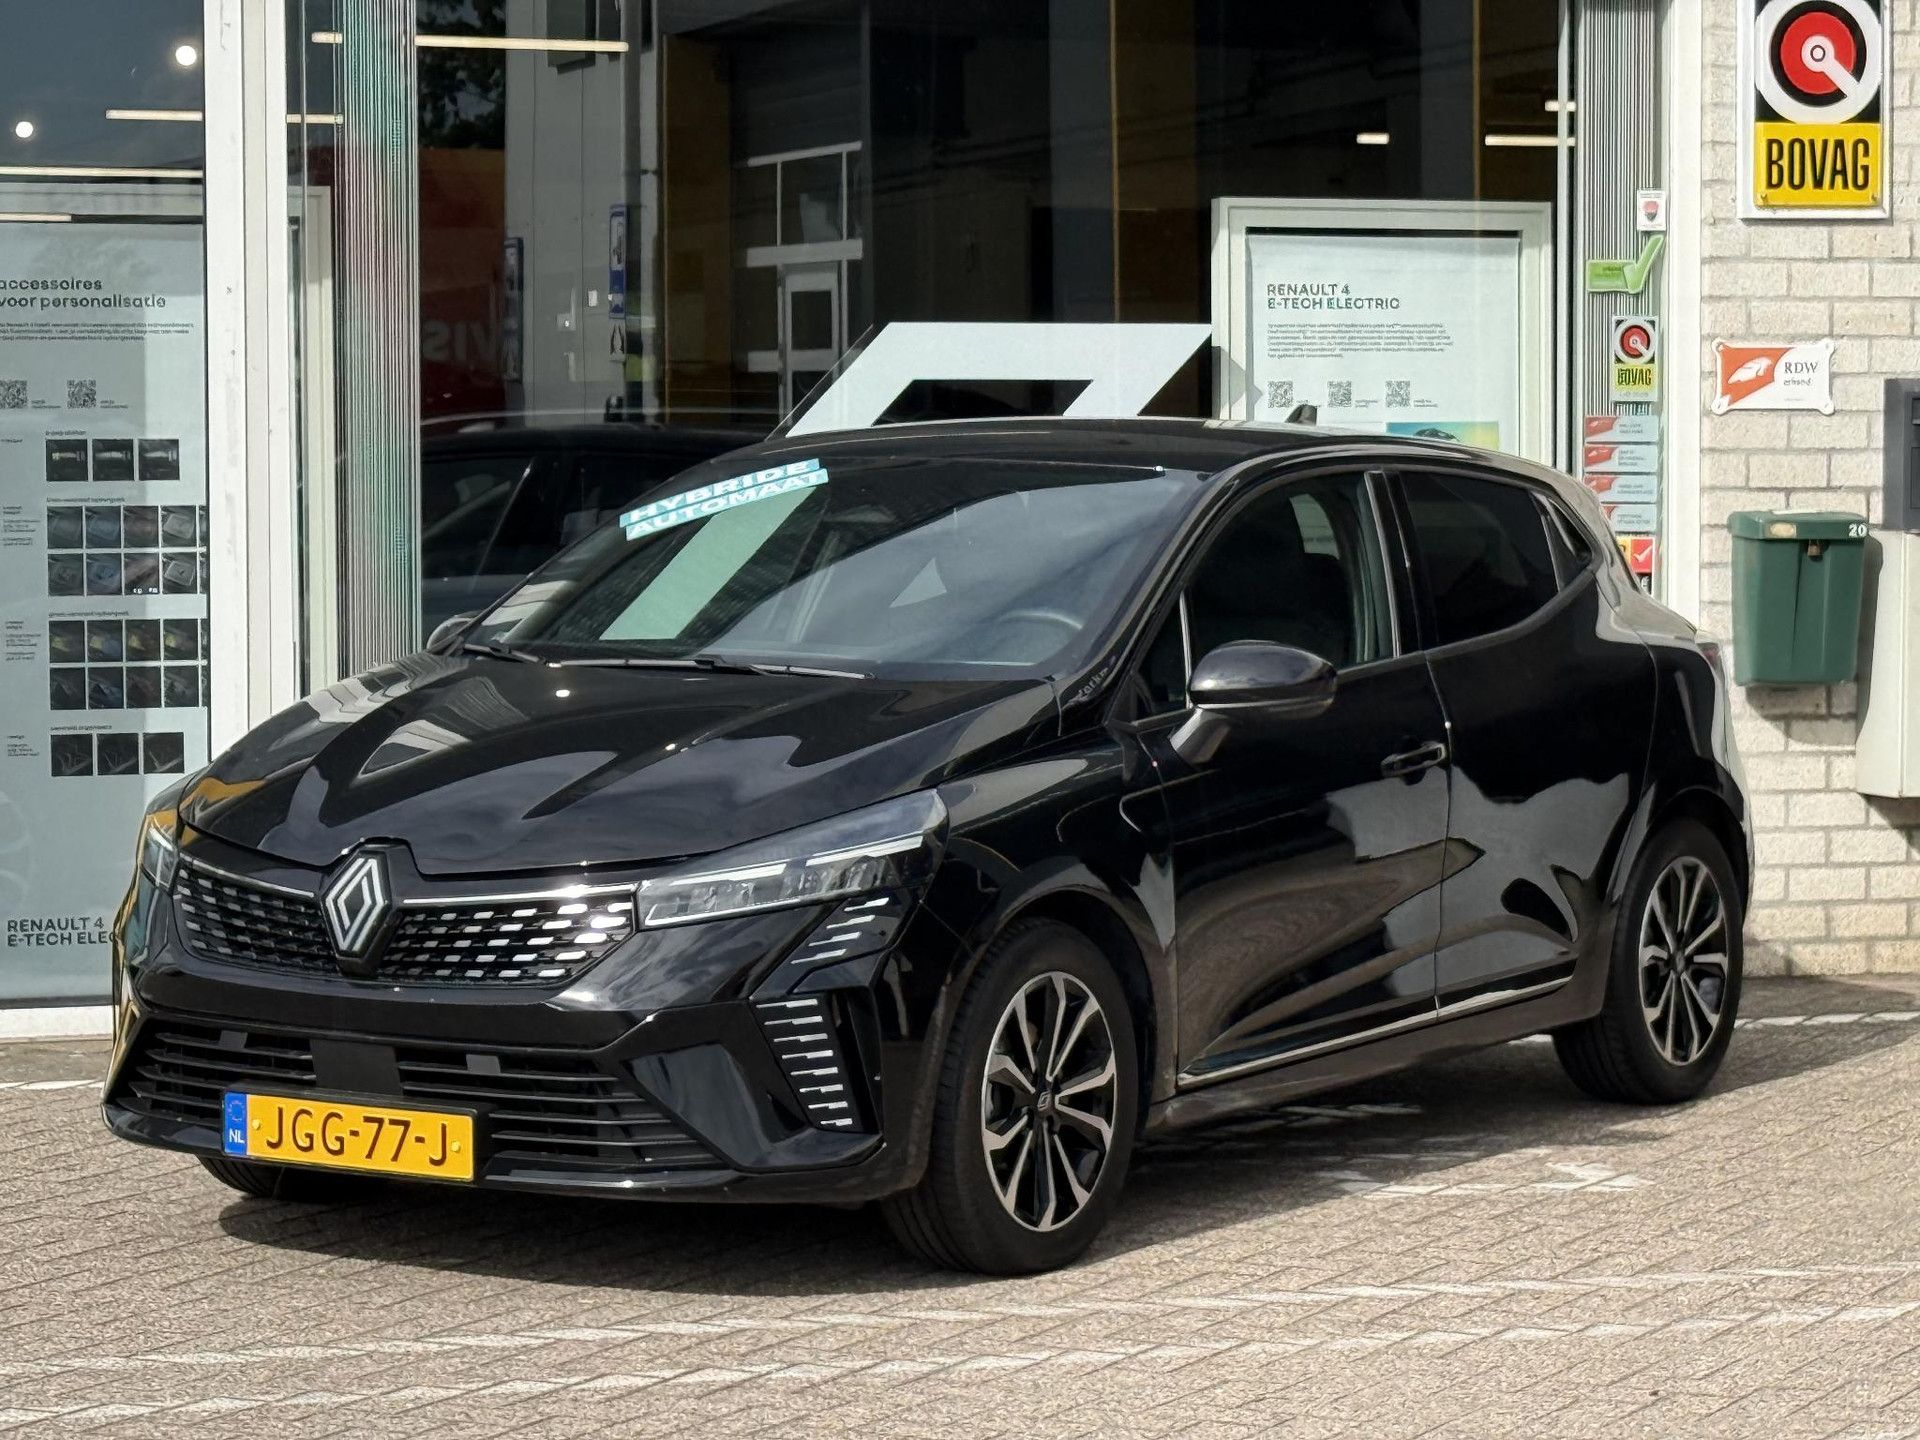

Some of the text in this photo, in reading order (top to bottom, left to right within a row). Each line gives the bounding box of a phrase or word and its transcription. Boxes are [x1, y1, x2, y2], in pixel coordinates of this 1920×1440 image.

[1765, 137, 1870, 190] BOVAG
[1266, 284, 1351, 296] RENAULT 4
[40, 294, 167, 310] personalisatie
[1267, 297, 1400, 310] E-TECH ELECTRIC
[1784, 361, 1818, 374] RDW
[1617, 367, 1652, 386] BOVAG
[630, 461, 809, 523] HYBRIDE
[627, 469, 823, 540] AUTOMAAT
[1849, 523, 1868, 537] 20
[7, 917, 104, 932] RENAULT 4
[7, 932, 72, 947] E-TECH
[229, 1129, 245, 1144] NL
[266, 1106, 447, 1167] JGG-77-J
